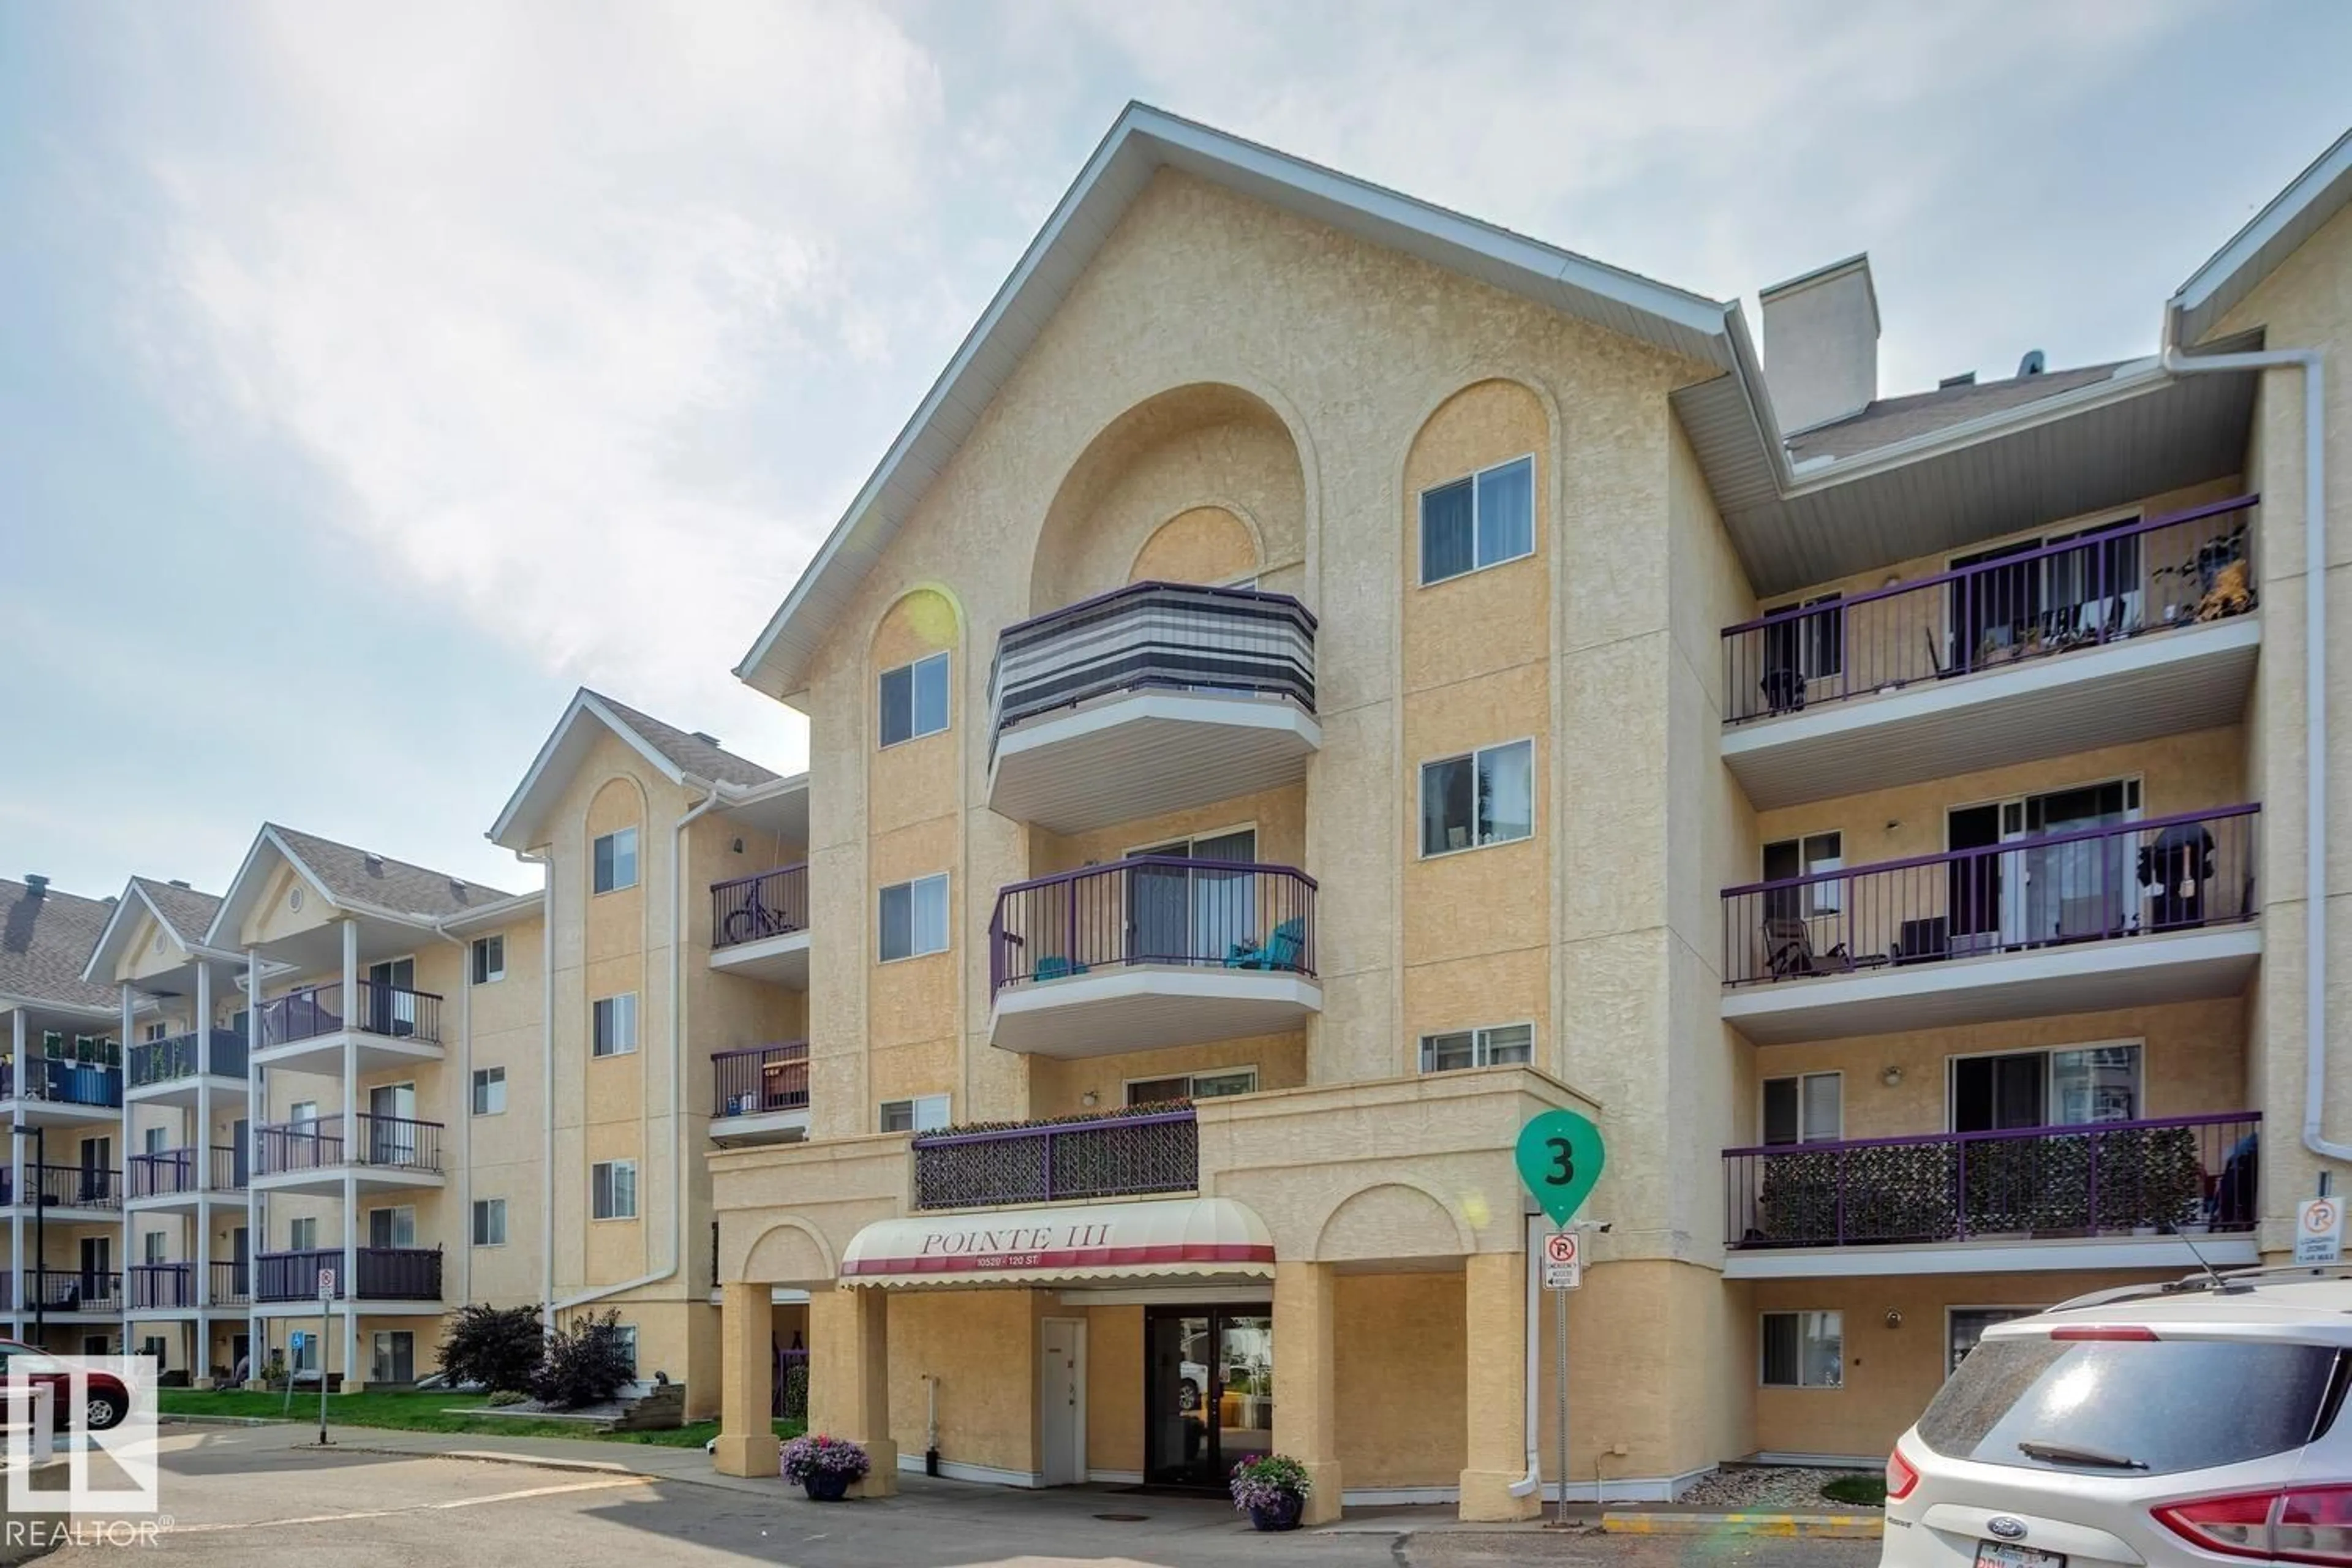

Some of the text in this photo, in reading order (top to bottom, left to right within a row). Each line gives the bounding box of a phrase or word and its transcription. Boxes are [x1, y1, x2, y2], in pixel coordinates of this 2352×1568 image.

[1545, 1137, 1574, 1186] 3
[921, 1224, 1113, 1254] POINTE III
[1008, 1255, 1023, 1265] 120
